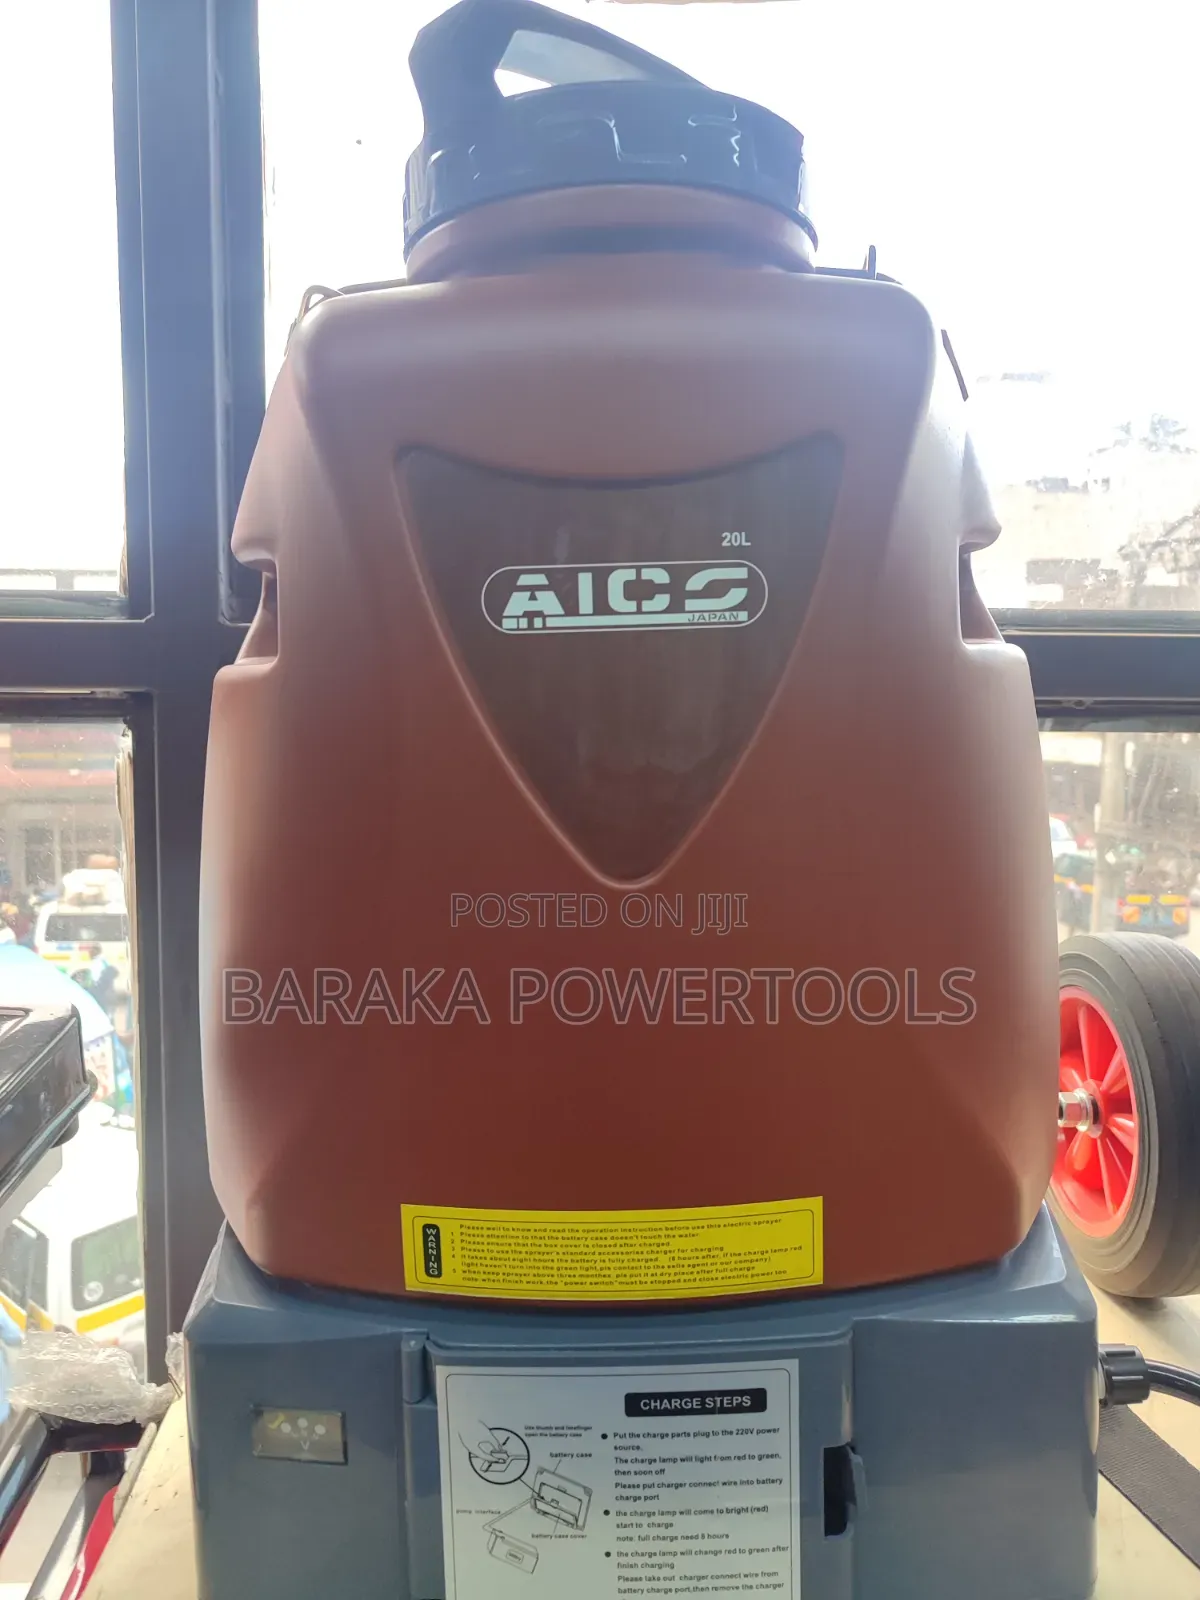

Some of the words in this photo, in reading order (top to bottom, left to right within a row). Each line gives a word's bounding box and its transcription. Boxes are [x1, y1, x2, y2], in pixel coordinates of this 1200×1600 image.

[721, 532, 751, 546] 20L
[687, 612, 739, 622] JAPAN
[426, 1228, 438, 1275] WARNING
[641, 1398, 701, 1410] CHARGE
[705, 1396, 751, 1408] STEPS
[643, 1431, 669, 1439] charge
[671, 1431, 690, 1439] parts
[693, 1430, 710, 1438] plug
[757, 1427, 780, 1435] power
[631, 1456, 657, 1465] charge
[659, 1456, 677, 1464] lamp
[695, 1455, 711, 1463] light
[643, 1482, 655, 1490] put
[657, 1481, 686, 1490] charger
[757, 1478, 782, 1486] battery
[615, 1495, 641, 1503] charge
[644, 1494, 659, 1502] port
[630, 1510, 656, 1518] charge
[658, 1509, 677, 1517] lamp
[726, 1507, 748, 1515] bright
[751, 1506, 768, 1514] (red)
[647, 1521, 673, 1530] charge
[652, 1534, 678, 1542] charge
[631, 1551, 657, 1559] charge
[659, 1550, 677, 1558] lamp
[748, 1547, 769, 1555] green
[641, 1562, 674, 1570] charging
[679, 1574, 708, 1582] charger
[618, 1587, 644, 1595] battery
[647, 1587, 672, 1595] charge
[756, 1582, 784, 1590] charger
